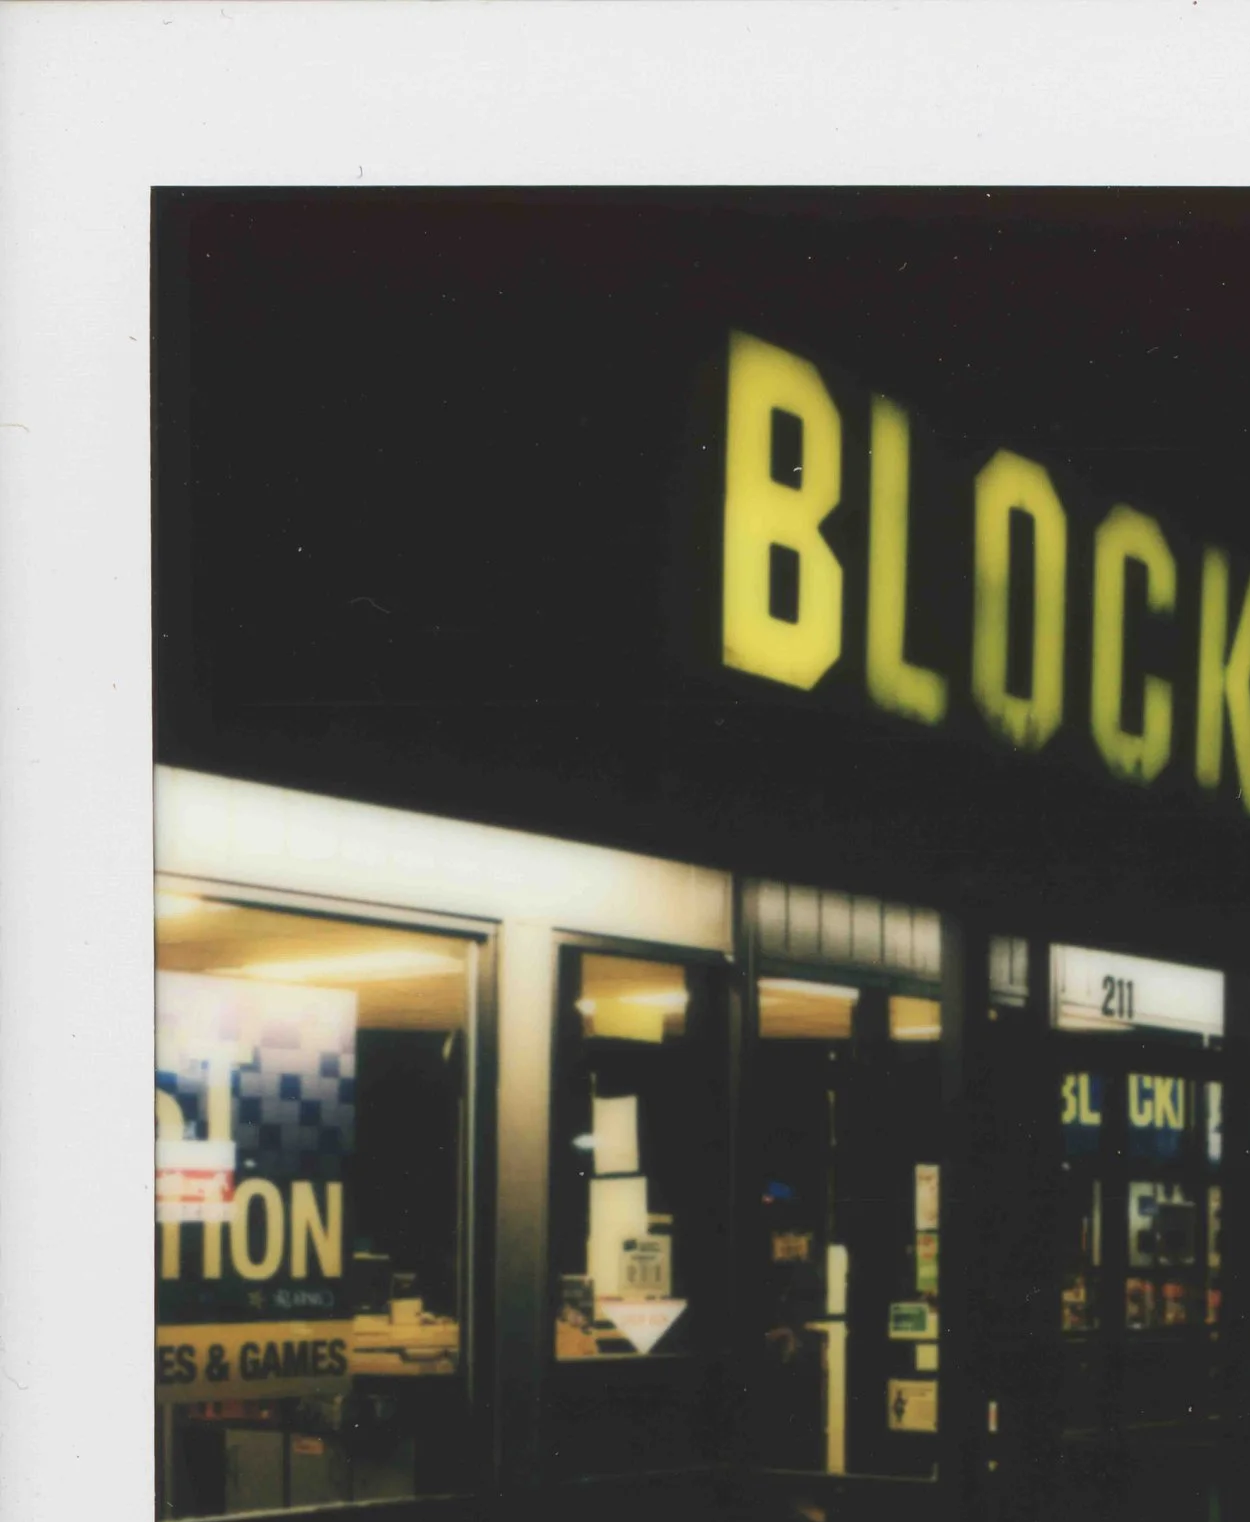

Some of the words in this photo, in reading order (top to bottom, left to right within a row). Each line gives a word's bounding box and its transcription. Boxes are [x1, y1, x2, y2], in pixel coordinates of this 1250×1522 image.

[1102, 974, 1134, 1019] 211
[205, 1343, 230, 1382] &
[239, 1338, 348, 1381] GAMES
